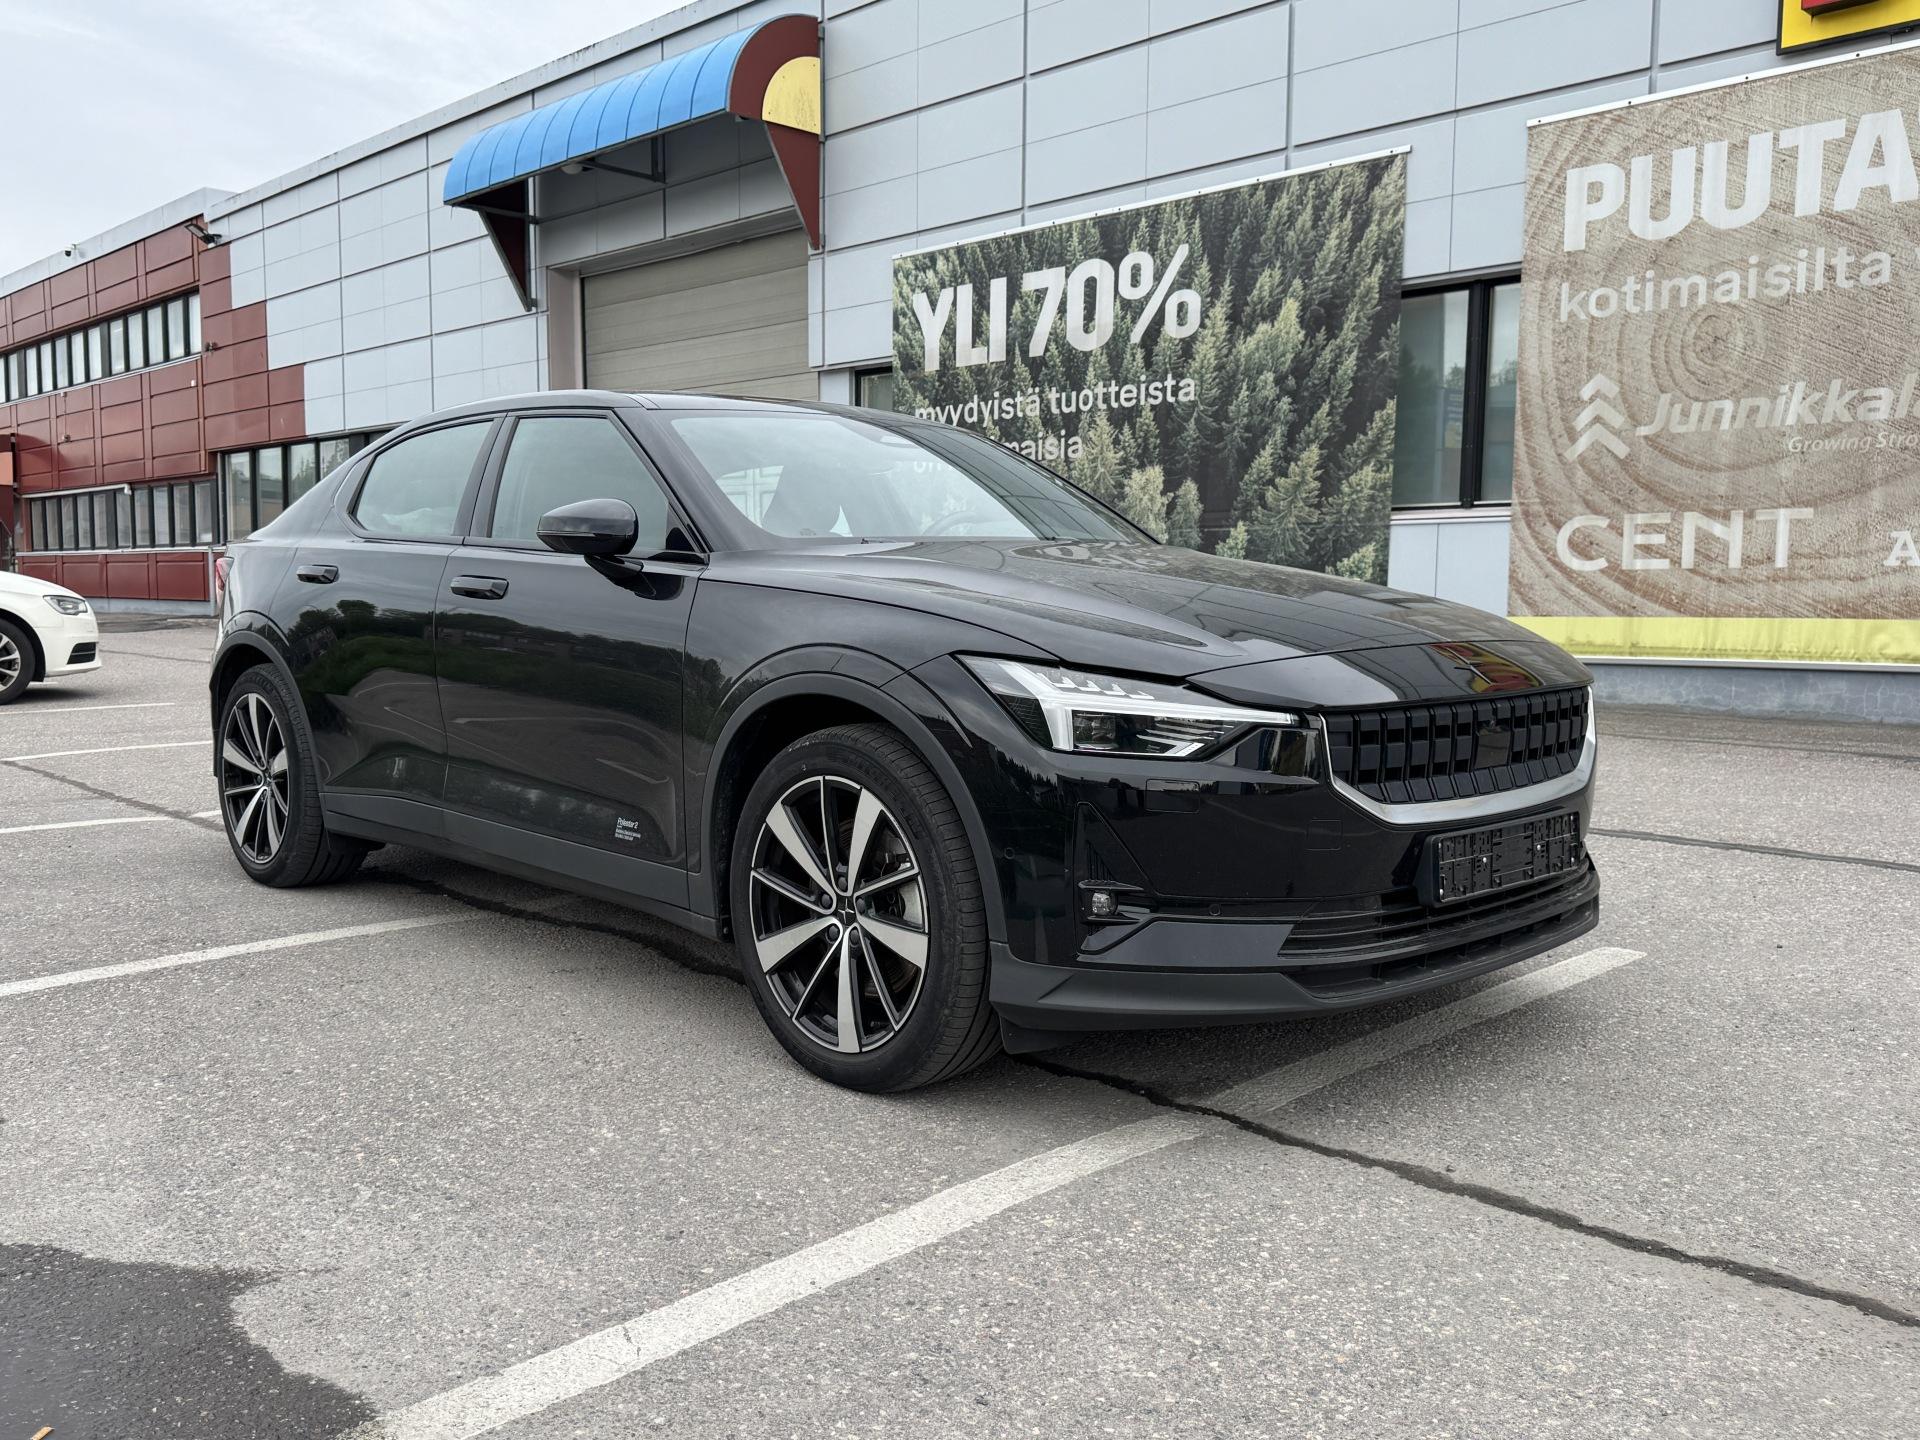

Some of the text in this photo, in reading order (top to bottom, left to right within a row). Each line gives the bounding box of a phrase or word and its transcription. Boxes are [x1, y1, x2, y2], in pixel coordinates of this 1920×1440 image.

[1563, 109, 1920, 251] PUUTA
[912, 244, 1202, 371] YLI 70%
[1560, 247, 1891, 322] kotimaisilta
[914, 373, 1195, 428] myydyistä tuotteista
[1788, 436, 1873, 453] Growing
[1556, 508, 1814, 572] CENT
